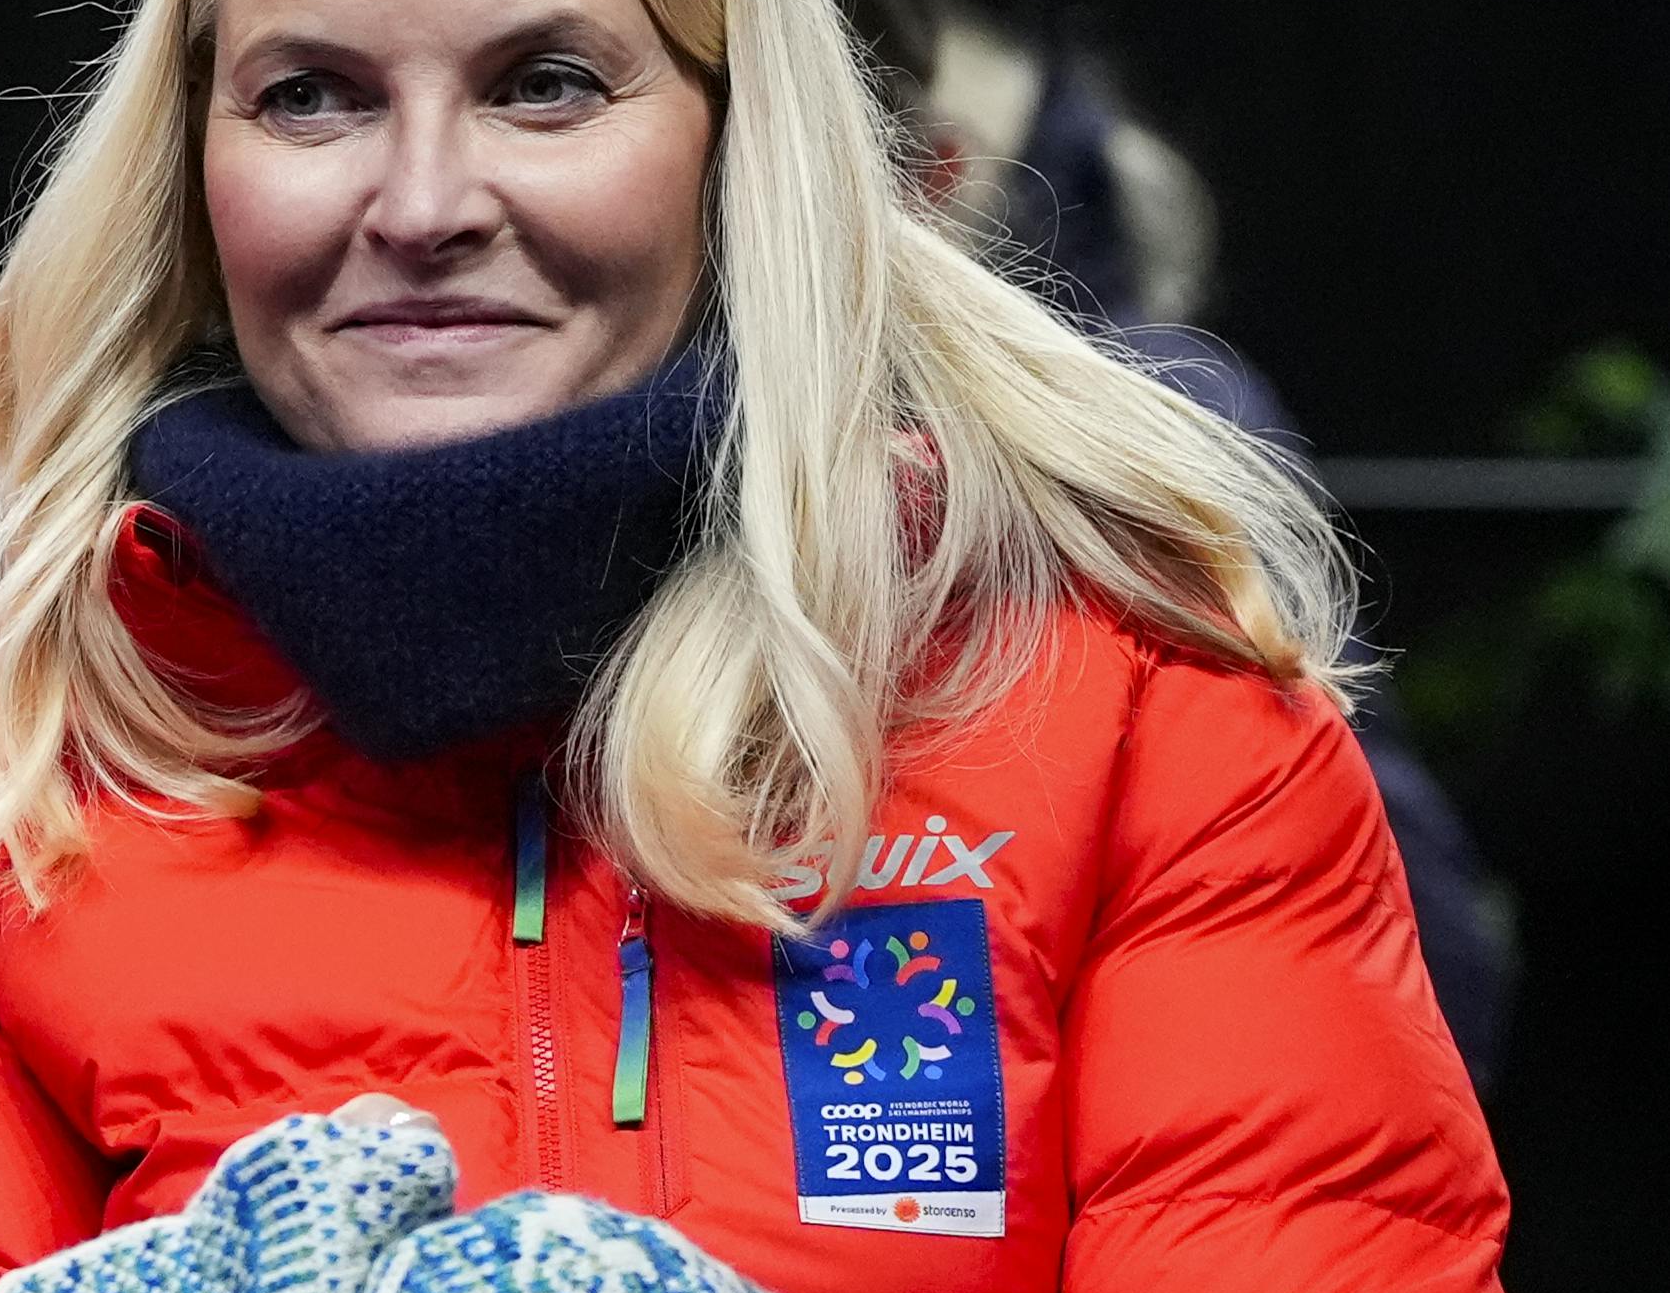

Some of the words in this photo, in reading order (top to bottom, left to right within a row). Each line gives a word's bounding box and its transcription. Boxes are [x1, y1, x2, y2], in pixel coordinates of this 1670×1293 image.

[904, 1101, 937, 1109] NORDIC
[938, 1100, 970, 1108] WORLD
[824, 1123, 974, 1142] TRONDHEIM
[825, 1144, 978, 1183] 2025
[830, 1205, 875, 1214] Presented
[876, 1205, 887, 1216] by
